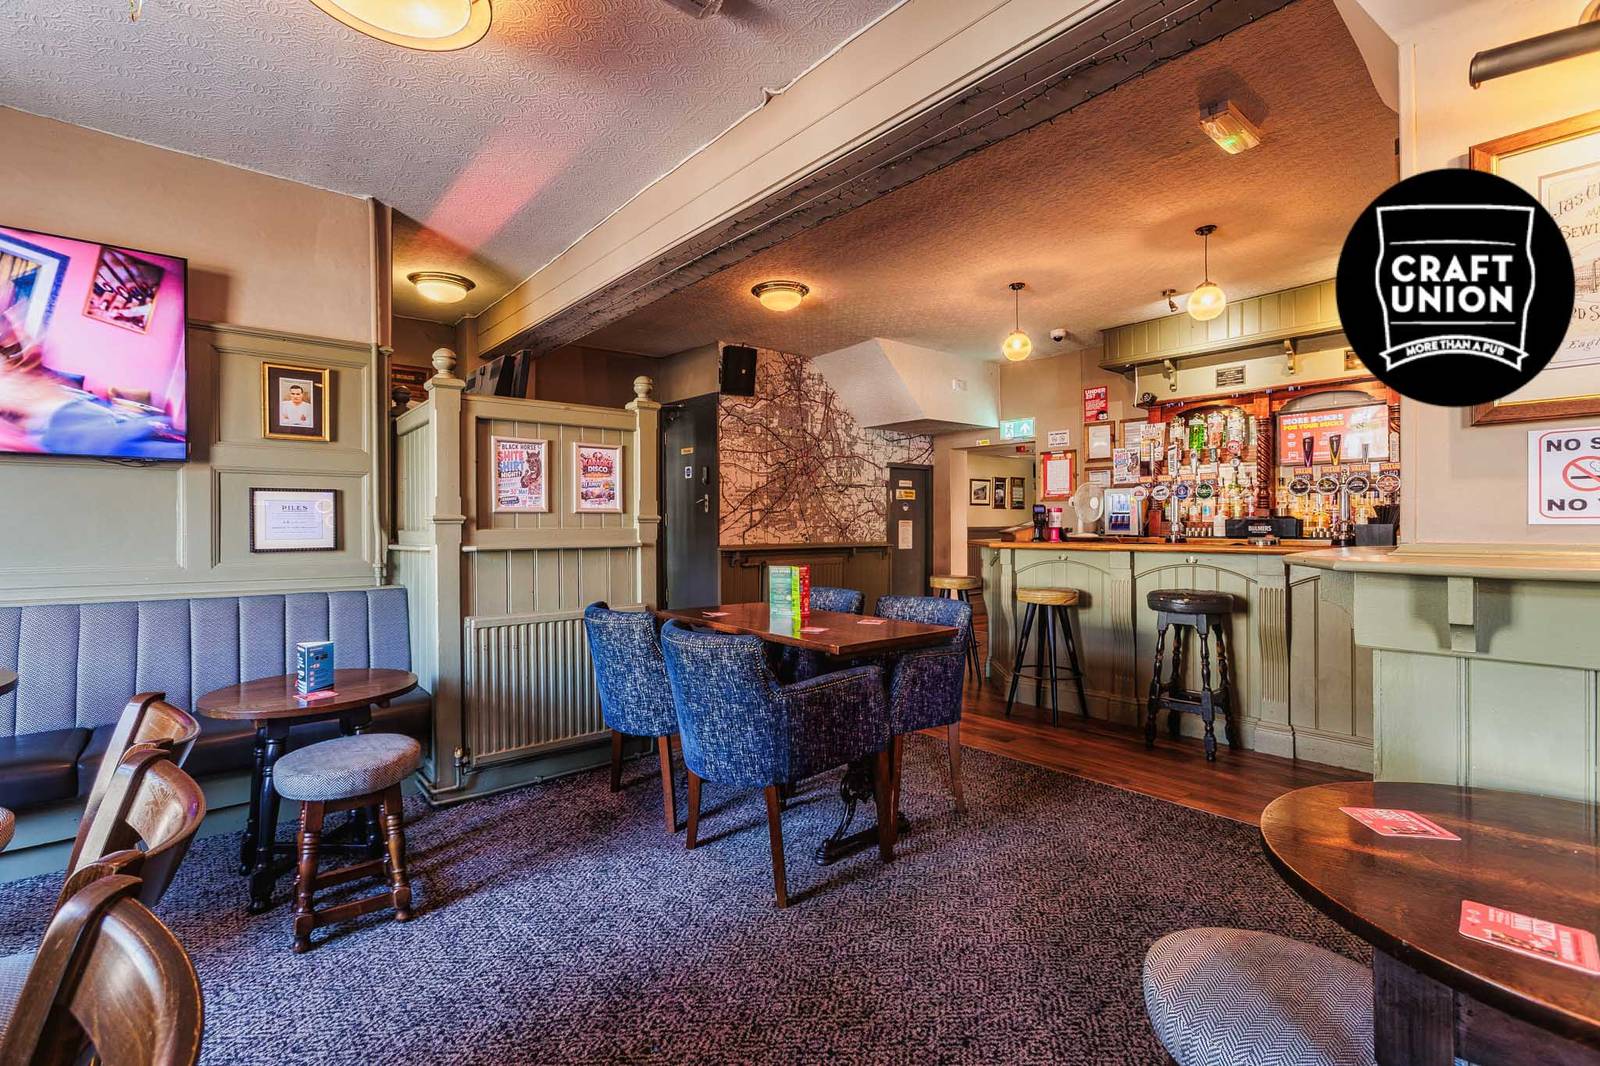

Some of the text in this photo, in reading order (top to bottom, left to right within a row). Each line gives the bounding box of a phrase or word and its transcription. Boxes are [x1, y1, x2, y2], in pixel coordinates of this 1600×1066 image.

[1546, 438, 1581, 452] NO
[587, 465, 609, 473] DISCO
[1547, 498, 1588, 511] NO
